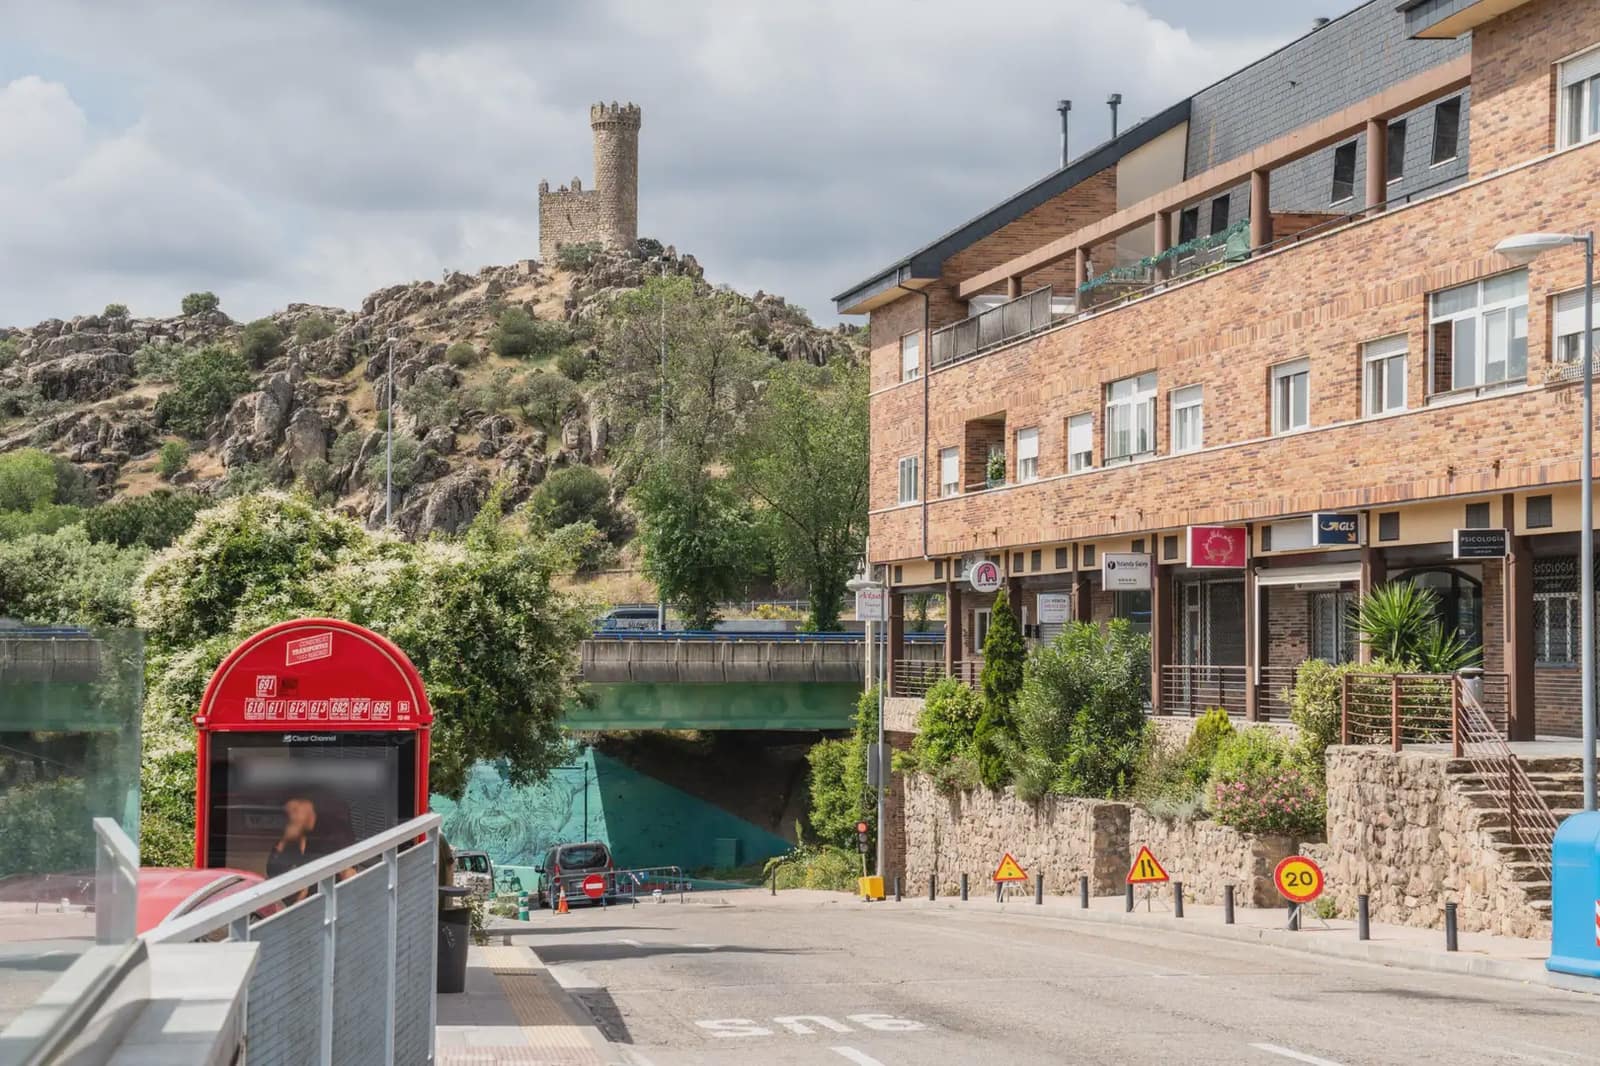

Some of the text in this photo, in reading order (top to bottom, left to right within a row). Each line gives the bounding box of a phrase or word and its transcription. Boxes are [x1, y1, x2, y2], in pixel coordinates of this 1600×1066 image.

[1339, 521, 1356, 531] GLS
[258, 679, 274, 690] 691
[247, 702, 264, 713] 610
[268, 702, 284, 713] 611
[289, 702, 306, 713] 612
[310, 702, 328, 713] 613
[332, 702, 347, 713] 682
[353, 702, 368, 713] 684
[373, 702, 389, 713] 685
[1284, 871, 1314, 887] 20
[694, 1013, 929, 1038] BUS
